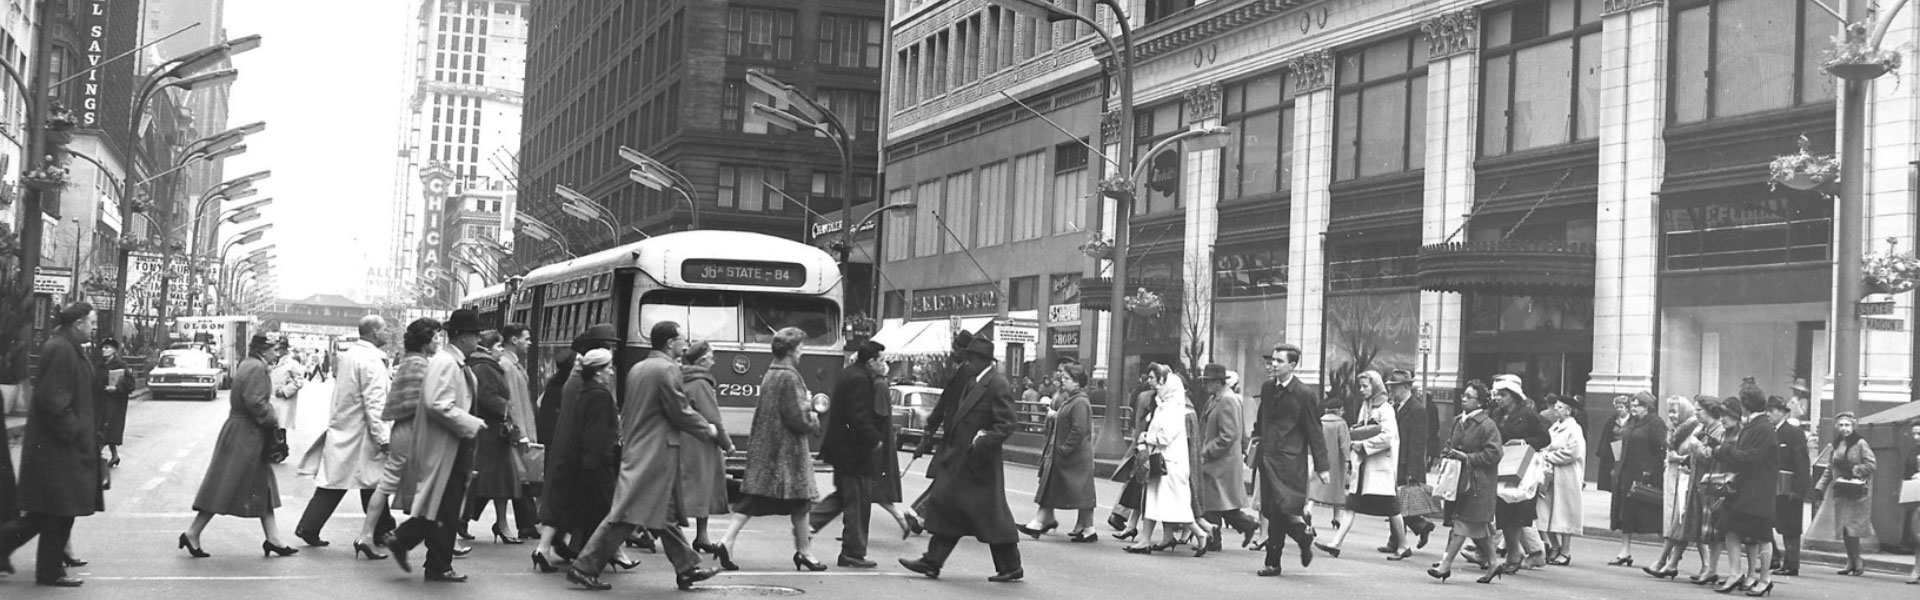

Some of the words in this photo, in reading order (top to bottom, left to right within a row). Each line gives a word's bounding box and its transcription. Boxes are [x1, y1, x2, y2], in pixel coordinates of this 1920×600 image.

[84, 25, 102, 124] SAVINGS
[422, 178, 443, 298] CHICAGO
[134, 262, 162, 272] TONY
[726, 266, 762, 280] STATE
[775, 268, 790, 281] 84
[183, 322, 225, 330] OLSON
[718, 383, 760, 397] 7291
